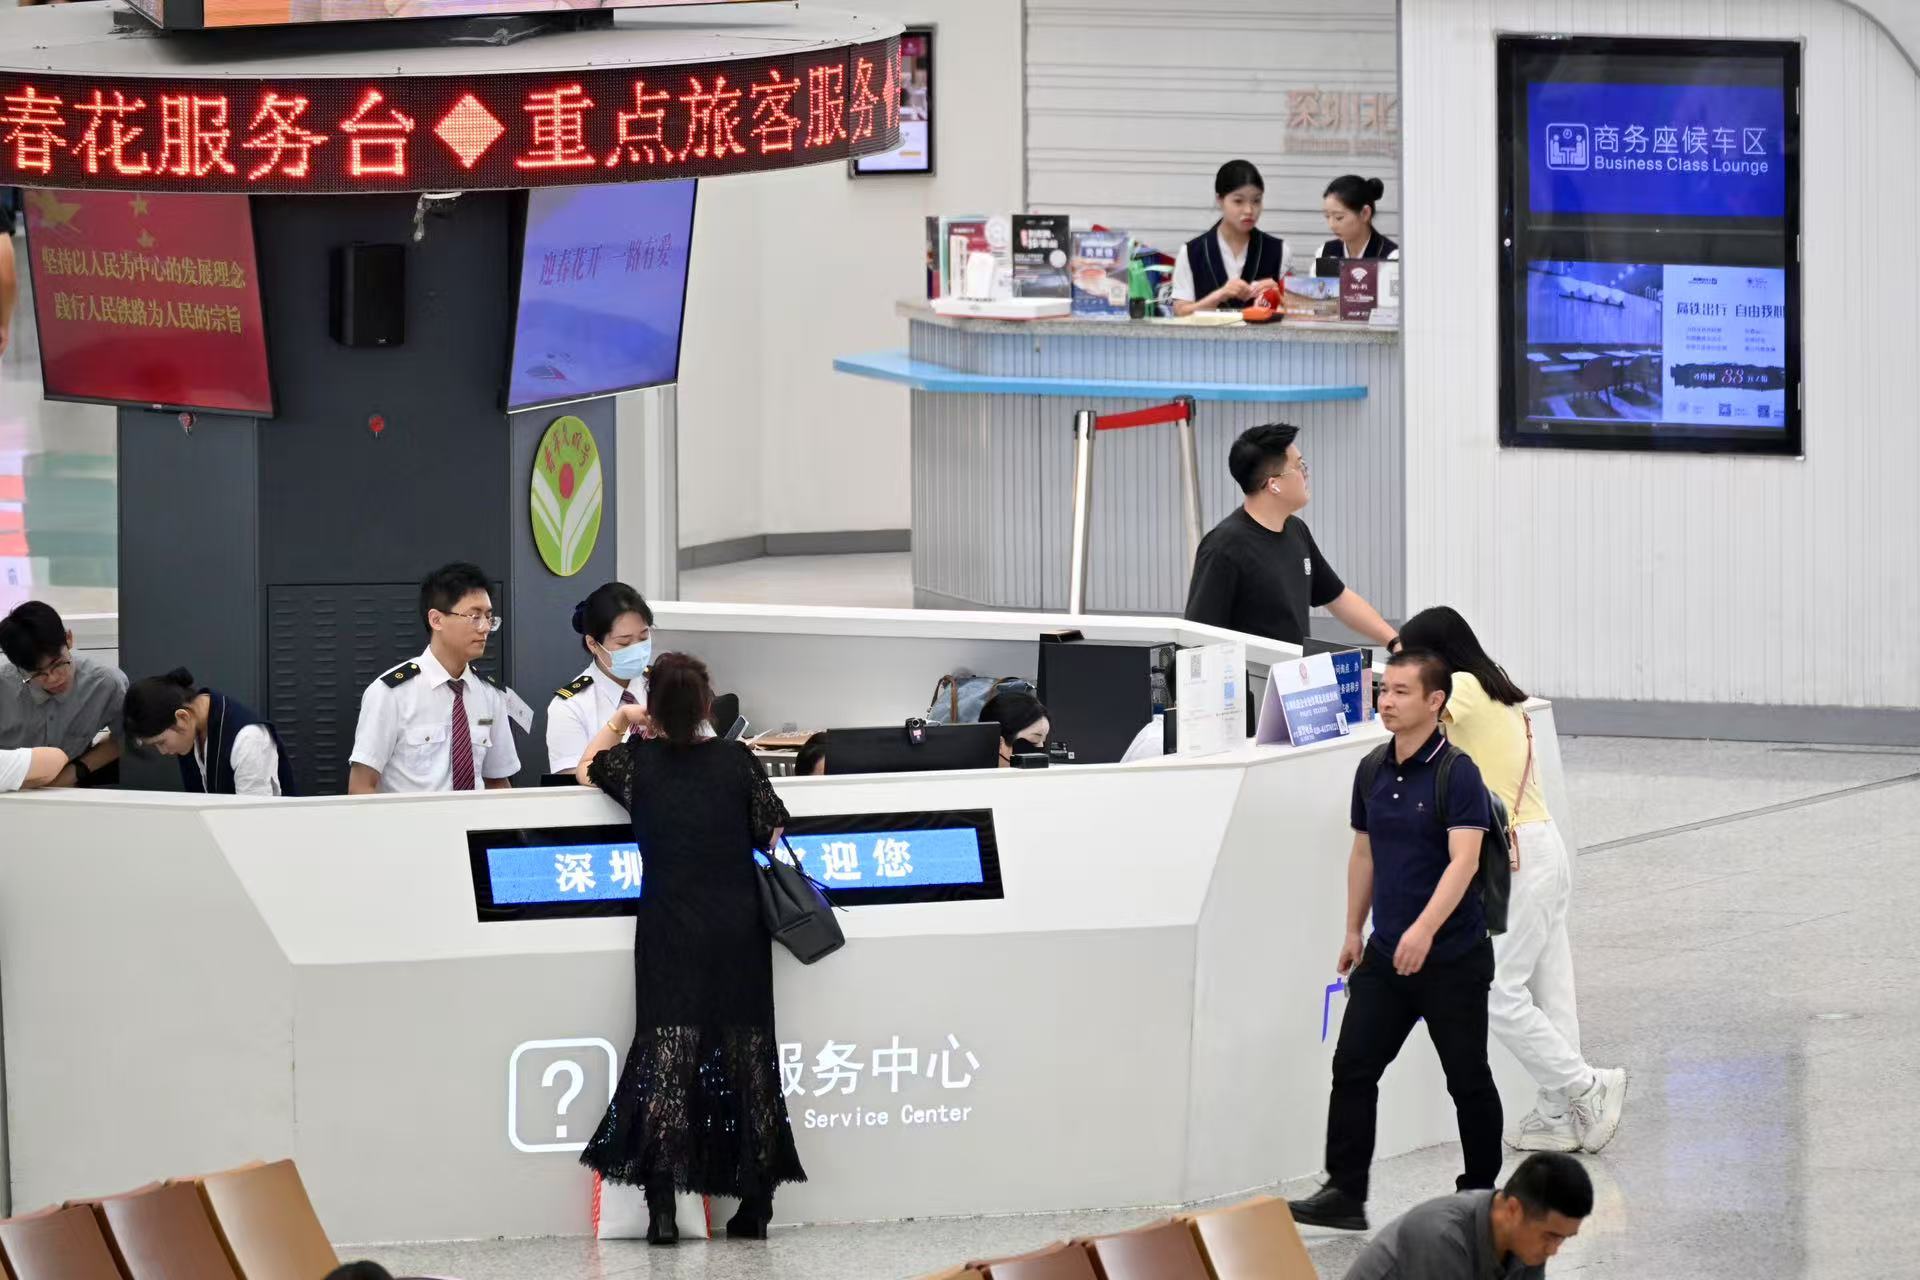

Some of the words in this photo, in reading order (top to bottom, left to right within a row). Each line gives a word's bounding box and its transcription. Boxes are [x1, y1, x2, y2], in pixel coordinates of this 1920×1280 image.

[516, 57, 878, 169] 重点旅客服务
[0, 87, 415, 180] 春花服务台
[1594, 124, 1767, 155] 商务座候车区
[1594, 155, 1663, 171] Business
[1667, 157, 1709, 171] Class
[1713, 158, 1769, 175] Lounge
[42, 248, 246, 289] 坚持以人民为中心的发展理念
[54, 292, 242, 334] 践行人民铁路为人民的宗旨
[1677, 302, 1728, 316] 高铁出行
[1721, 368, 1744, 384] 88
[554, 849, 643, 893] 深圳
[804, 1107, 889, 1128] Service
[901, 1104, 972, 1124] Center
